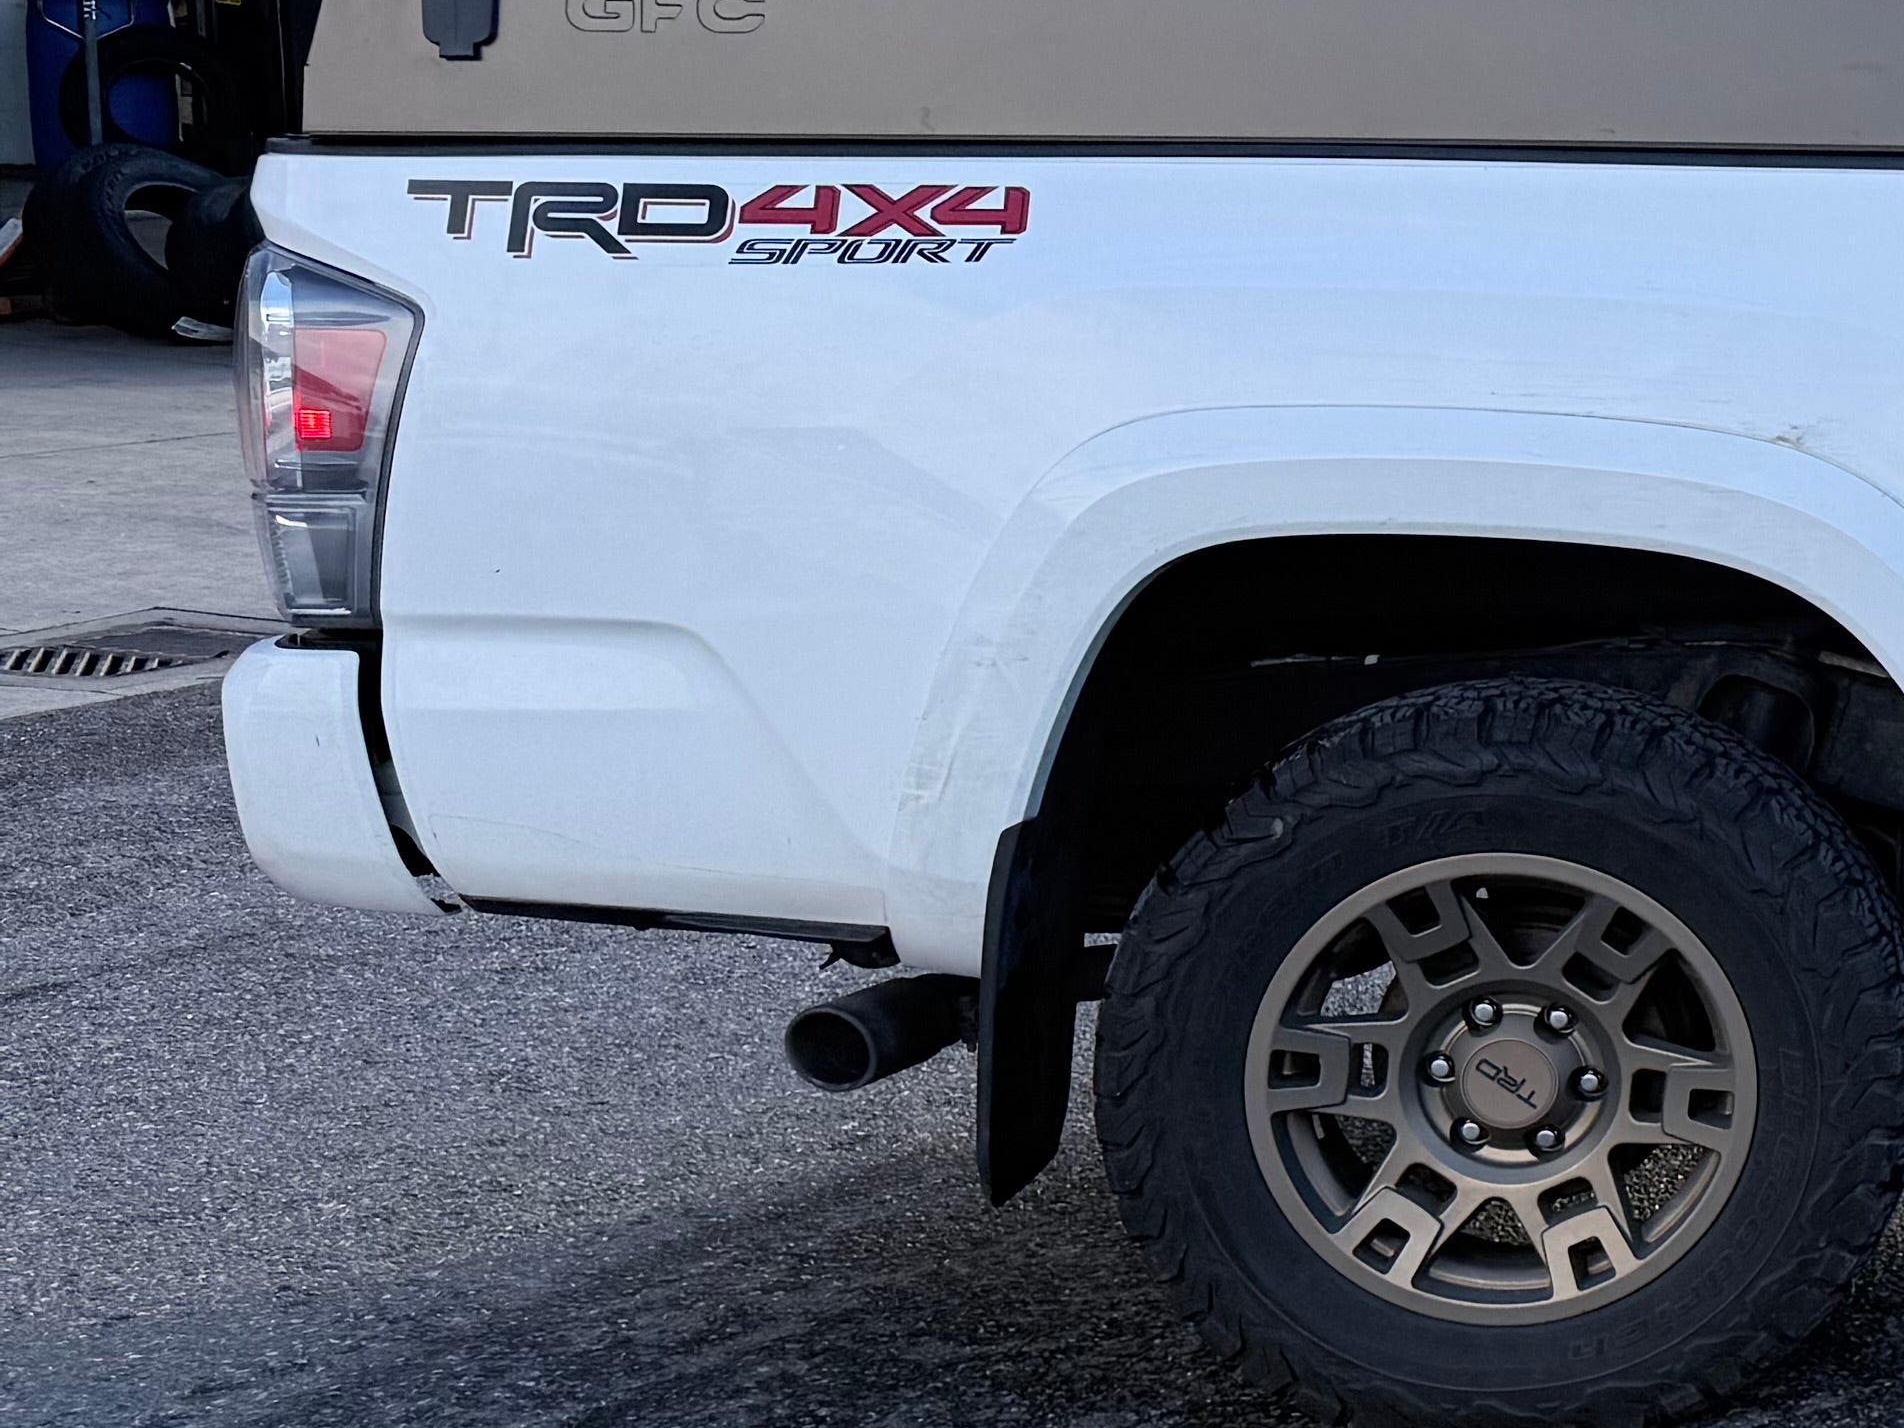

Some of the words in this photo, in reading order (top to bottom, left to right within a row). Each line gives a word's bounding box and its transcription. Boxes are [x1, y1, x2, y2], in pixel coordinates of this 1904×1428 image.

[406, 179, 734, 261] TRD
[737, 183, 1031, 238] 4X4
[728, 238, 1018, 266] SPORT
[1475, 1058, 1538, 1110] TRD
